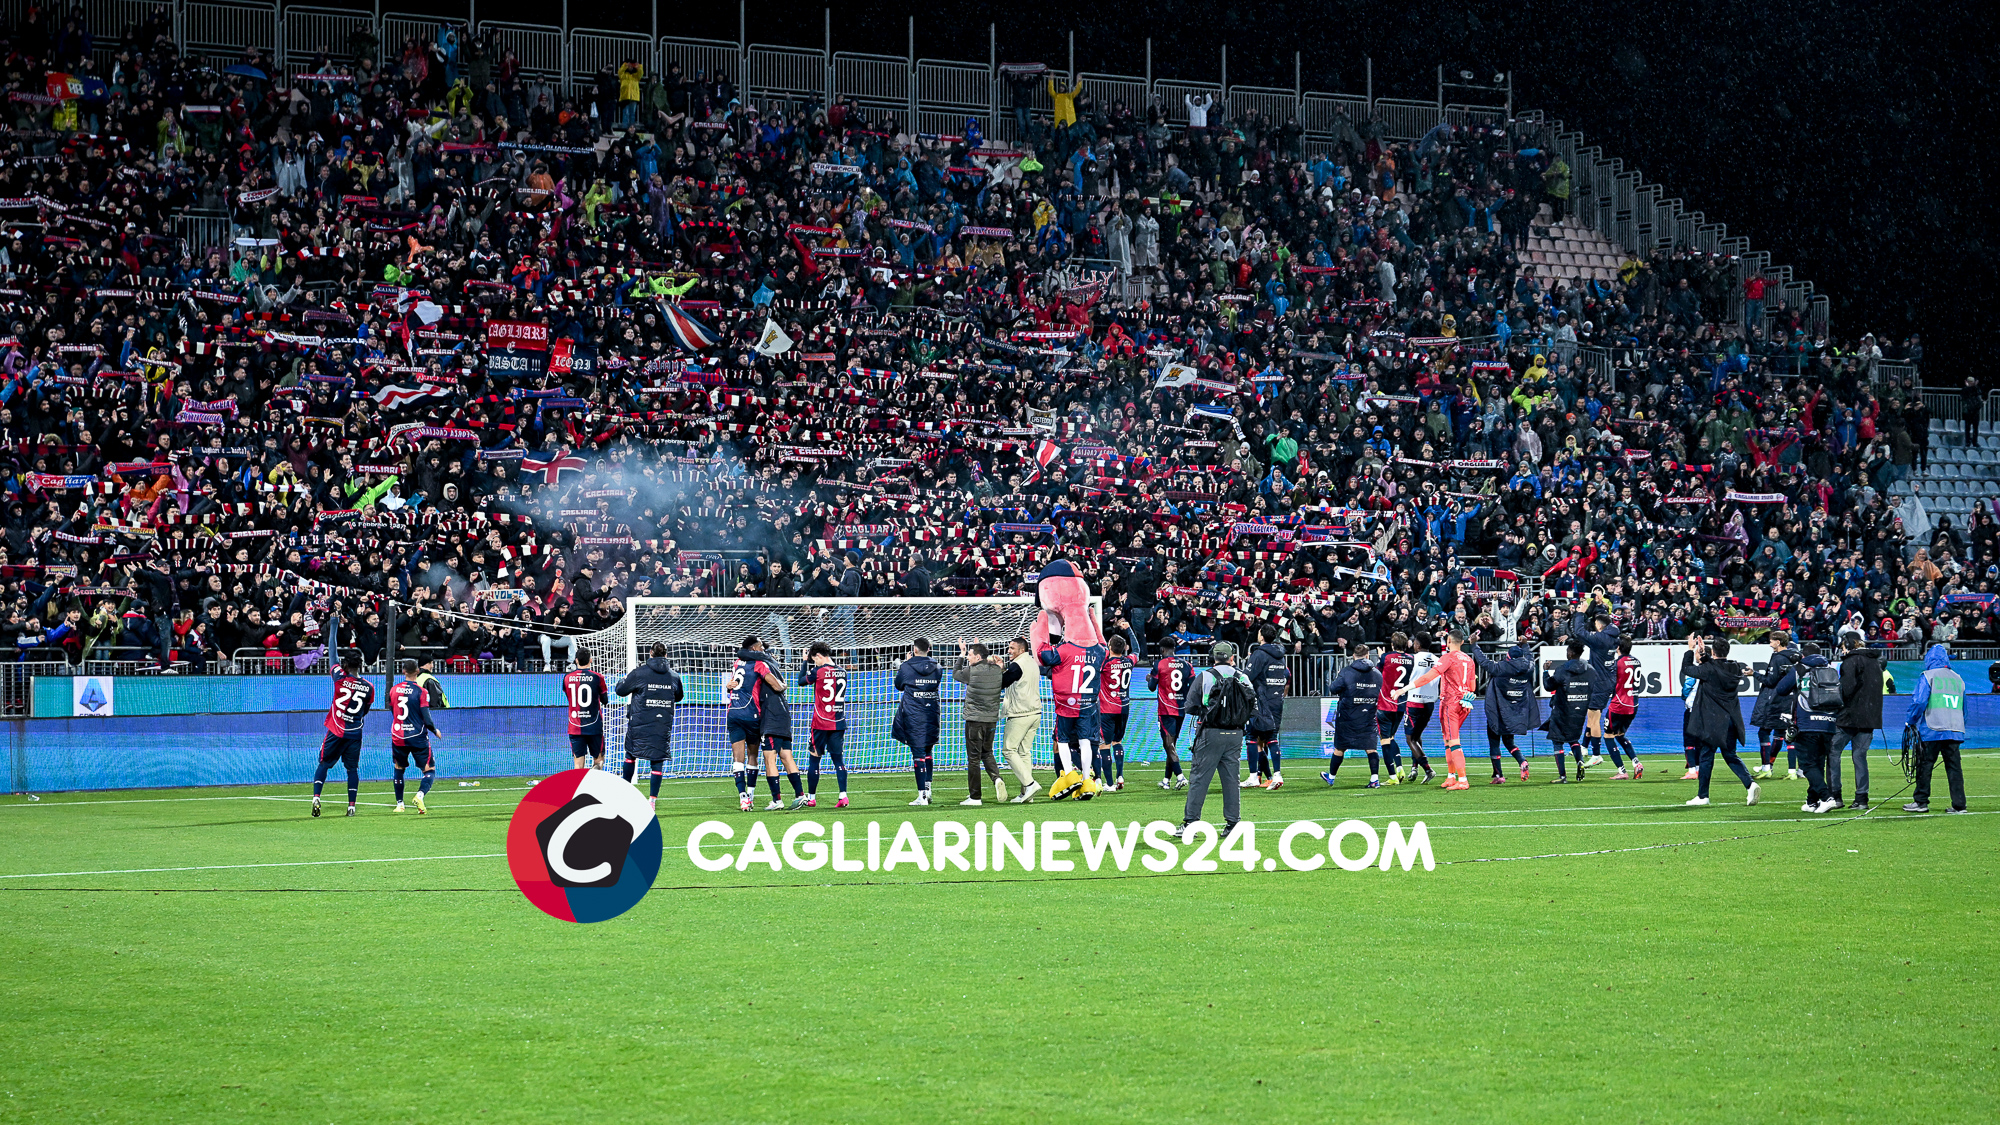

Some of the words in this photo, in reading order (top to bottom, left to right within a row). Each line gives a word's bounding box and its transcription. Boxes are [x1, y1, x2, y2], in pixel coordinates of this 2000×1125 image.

[195, 291, 240, 303] CAGLIARI
[418, 331, 461, 340] CAGLIARI
[488, 324, 547, 340] CAGLIARI
[358, 465, 399, 475] CAGLIARI
[41, 474, 90, 486] Cagliari
[318, 509, 359, 520] Cagliari
[55, 530, 100, 543] CAGLIARI
[1074, 655, 1096, 664] PULLY
[1390, 657, 1413, 665] PALESTRA
[1070, 664, 1096, 694] 12
[1108, 668, 1132, 690] 30
[1170, 669, 1183, 692] 8
[1393, 665, 1407, 688] 2
[1462, 662, 1468, 684] 1
[1623, 666, 1642, 689] 29
[342, 680, 370, 693] SULEMANA
[821, 678, 846, 703] 32
[335, 687, 367, 714] 25
[568, 683, 593, 708] 10
[1942, 694, 1959, 708] TV
[396, 696, 409, 721] 3
